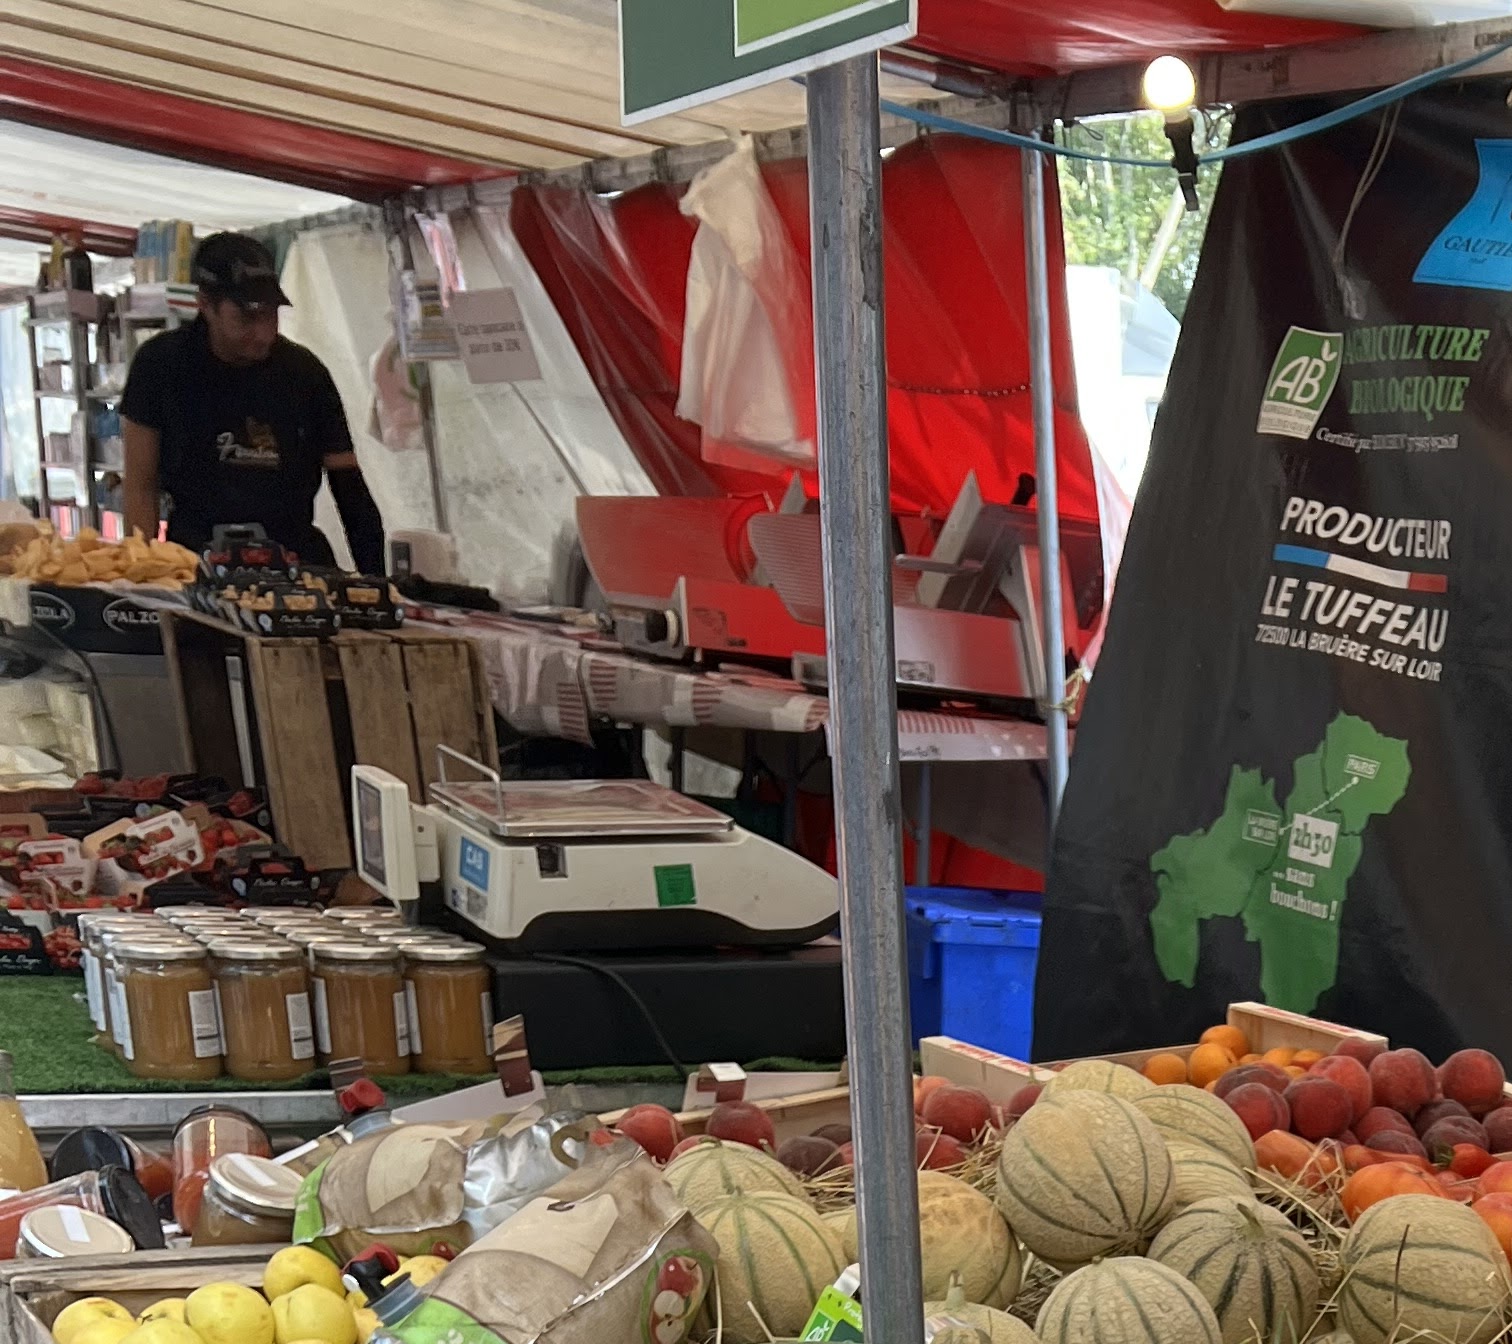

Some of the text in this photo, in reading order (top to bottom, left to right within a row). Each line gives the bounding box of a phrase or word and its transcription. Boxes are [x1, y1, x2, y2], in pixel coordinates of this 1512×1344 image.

[1343, 324, 1490, 365] AGRICULTURE
[1269, 355, 1327, 404] AB
[1348, 376, 1470, 421] BIOLOGIQUE
[1280, 496, 1451, 560] PRODUCTEUR
[1261, 575, 1449, 652] LE TUFFEAU
[1289, 628, 1307, 649] LA
[1307, 634, 1371, 663] BRUÈRE
[1368, 648, 1407, 674] SUR
[1406, 658, 1443, 682] LOIR
